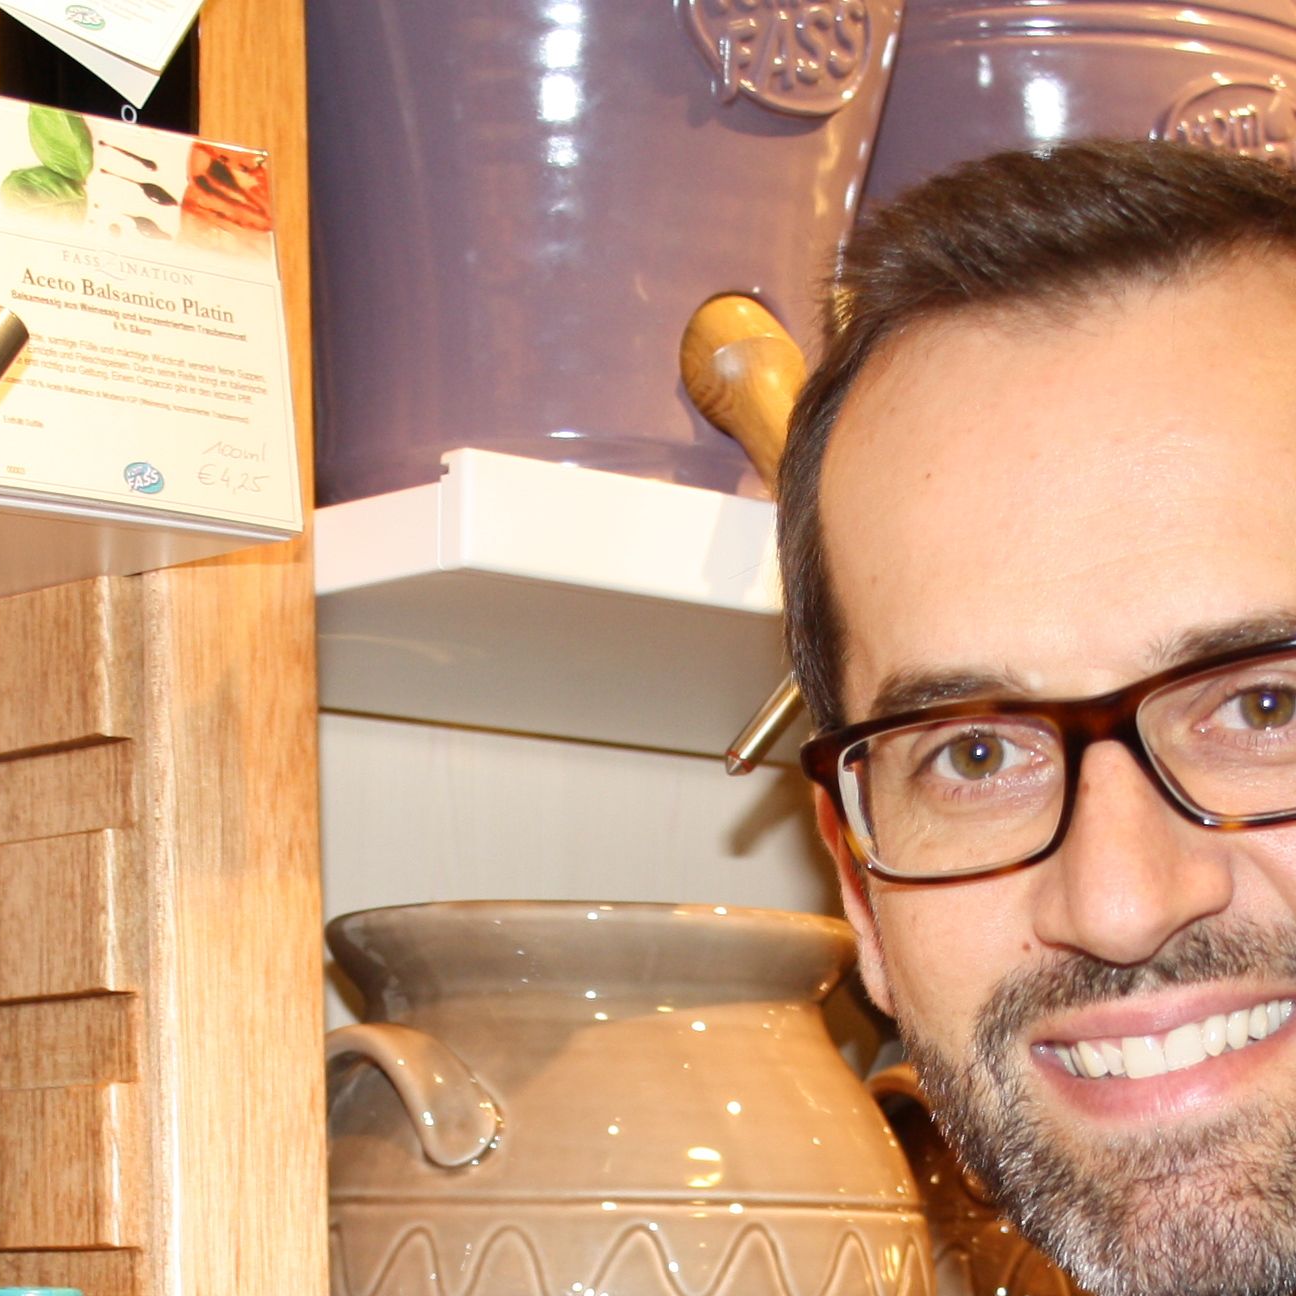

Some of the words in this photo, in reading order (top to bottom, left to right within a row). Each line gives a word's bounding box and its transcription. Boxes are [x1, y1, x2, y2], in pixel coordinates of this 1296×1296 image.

[21, 269, 75, 292] Aceto
[81, 279, 176, 311] Balsamico
[181, 298, 234, 323] Platin
[220, 468, 270, 494] 4,25
